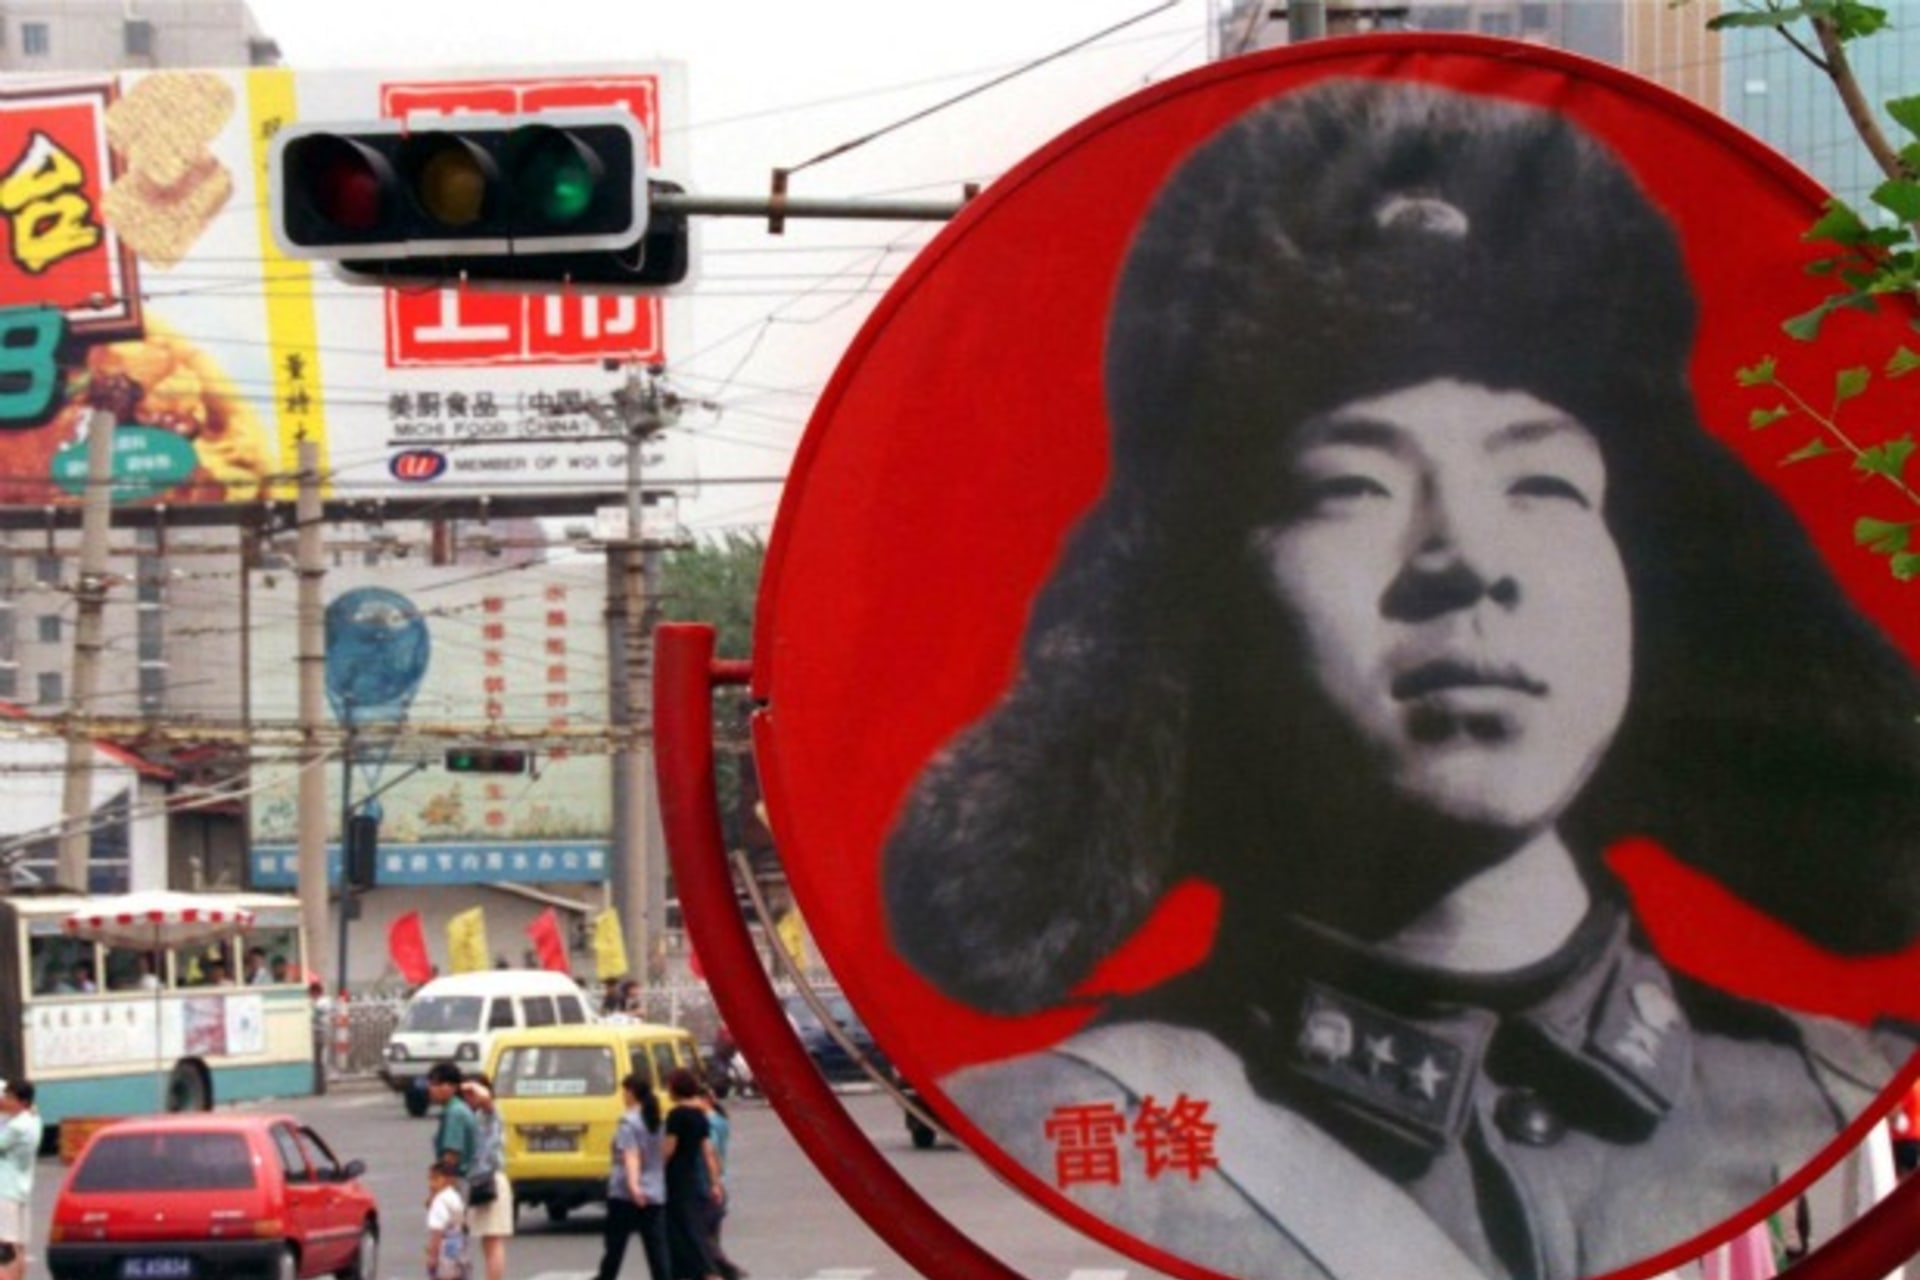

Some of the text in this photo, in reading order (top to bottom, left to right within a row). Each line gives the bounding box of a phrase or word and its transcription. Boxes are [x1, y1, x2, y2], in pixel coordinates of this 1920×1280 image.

[454, 418, 509, 436] FOOD
[454, 457, 527, 471] MEMBER
[535, 455, 558, 470] OF
[1044, 1092, 1219, 1188] 雷锋
